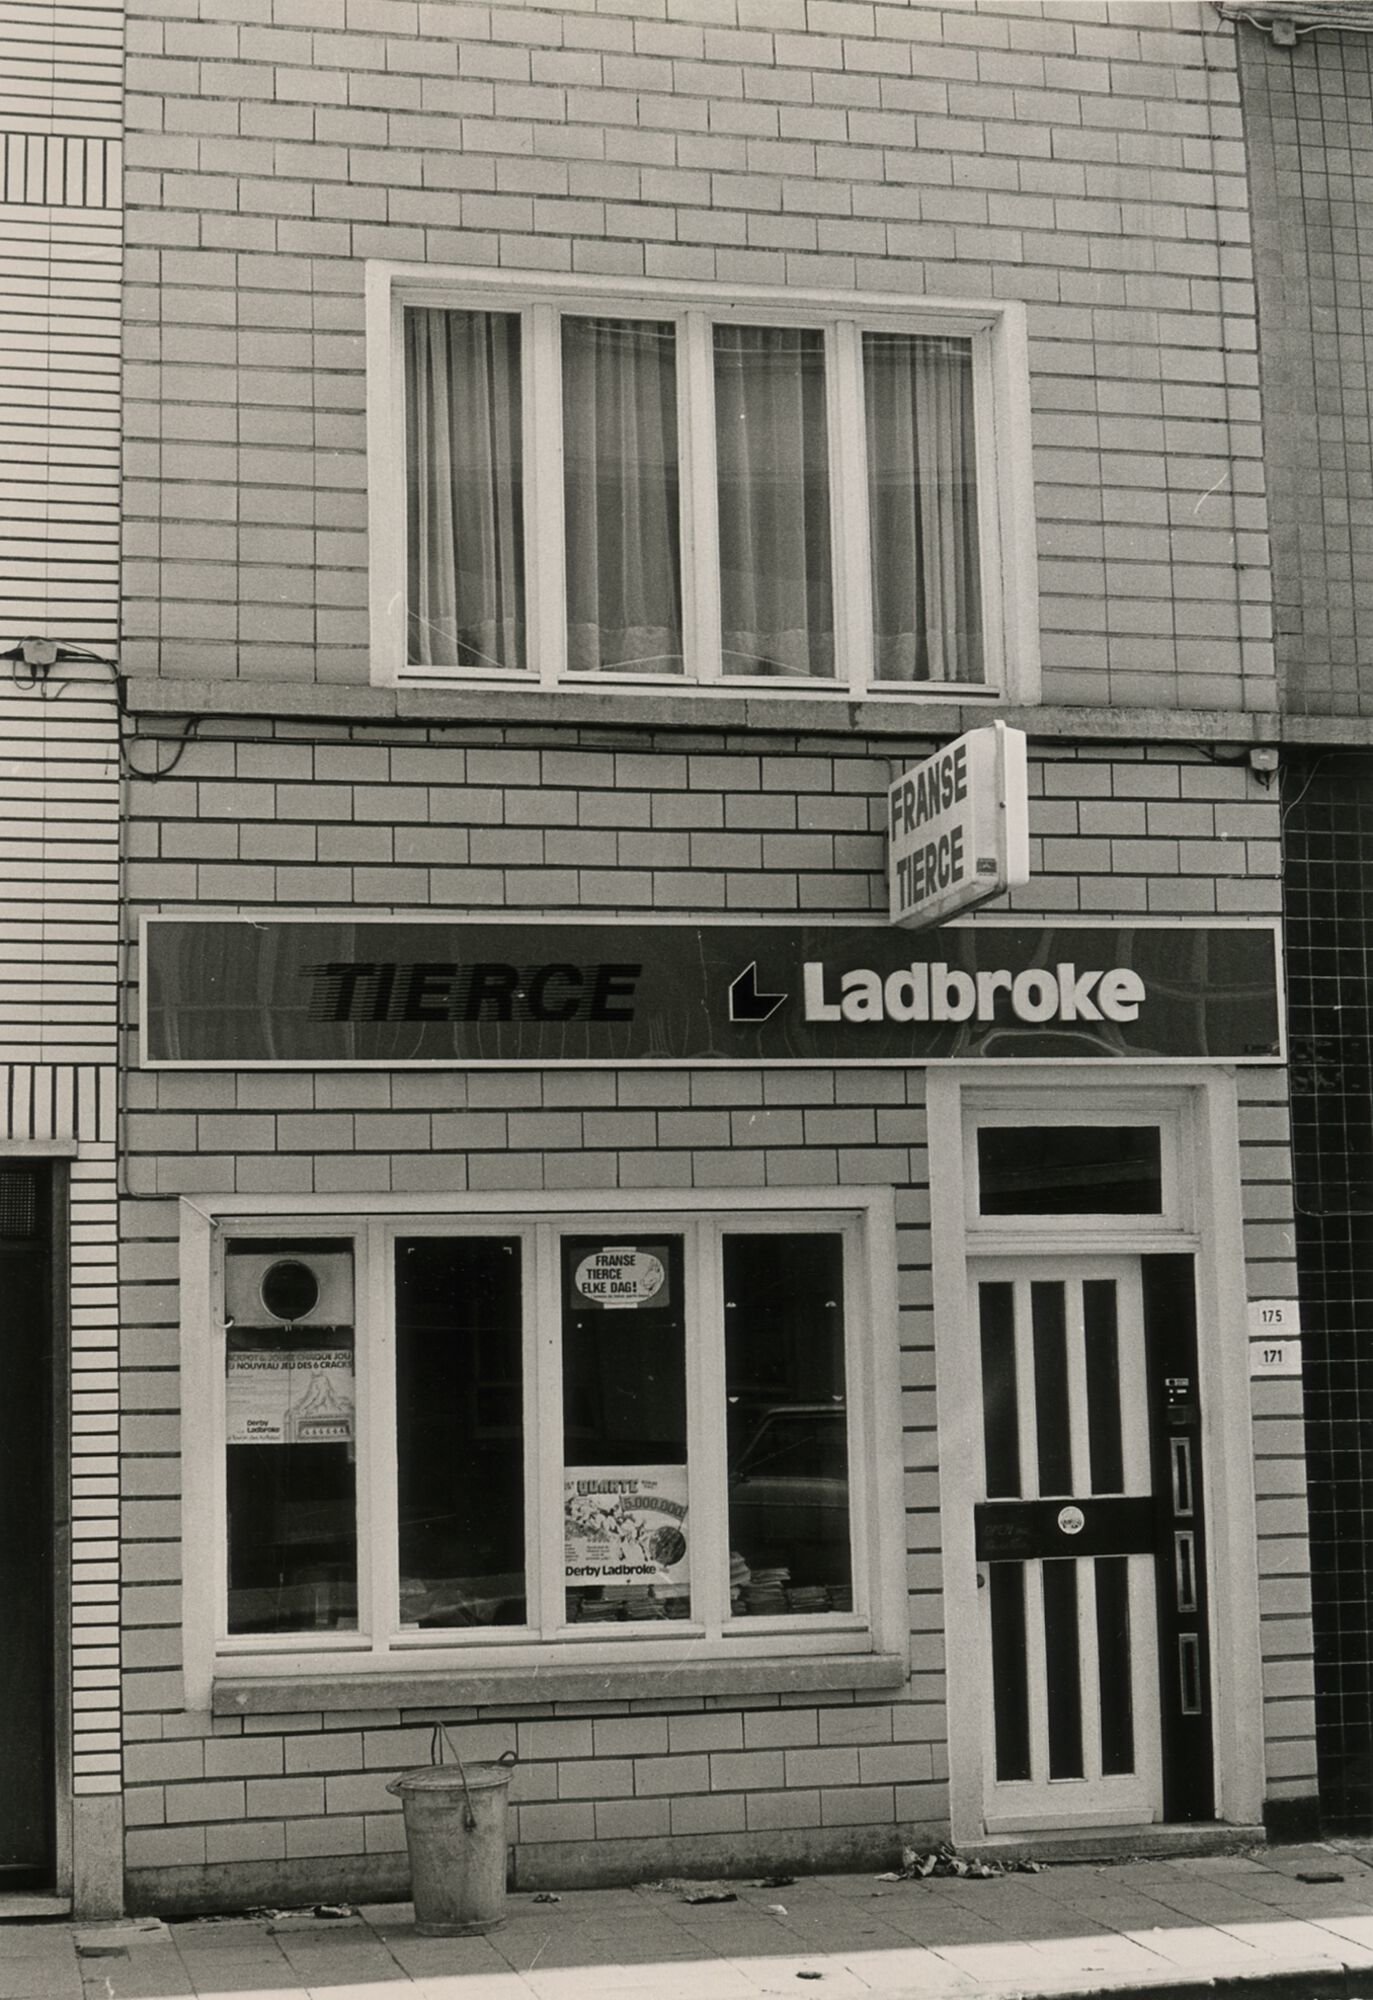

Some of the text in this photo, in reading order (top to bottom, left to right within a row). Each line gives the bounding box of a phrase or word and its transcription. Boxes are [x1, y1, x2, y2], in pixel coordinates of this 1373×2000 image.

[891, 744, 967, 842] FRANSE
[897, 825, 964, 912] TIERCE
[304, 963, 643, 1022] TIERCE
[803, 962, 1146, 1022] Ladbroke
[595, 1254, 636, 1266] FRANSE
[586, 1268, 622, 1280] TIERCE
[582, 1281, 637, 1293] ELKE DAG!
[1262, 1310, 1282, 1322] 175
[1264, 1349, 1282, 1362] 171
[237, 1361, 279, 1370] NOUVEAU
[280, 1361, 296, 1370] JEU
[297, 1360, 312, 1369] DES
[313, 1360, 319, 1369] 6
[565, 1566, 600, 1577] Derby
[602, 1564, 656, 1576] Ladbroke
